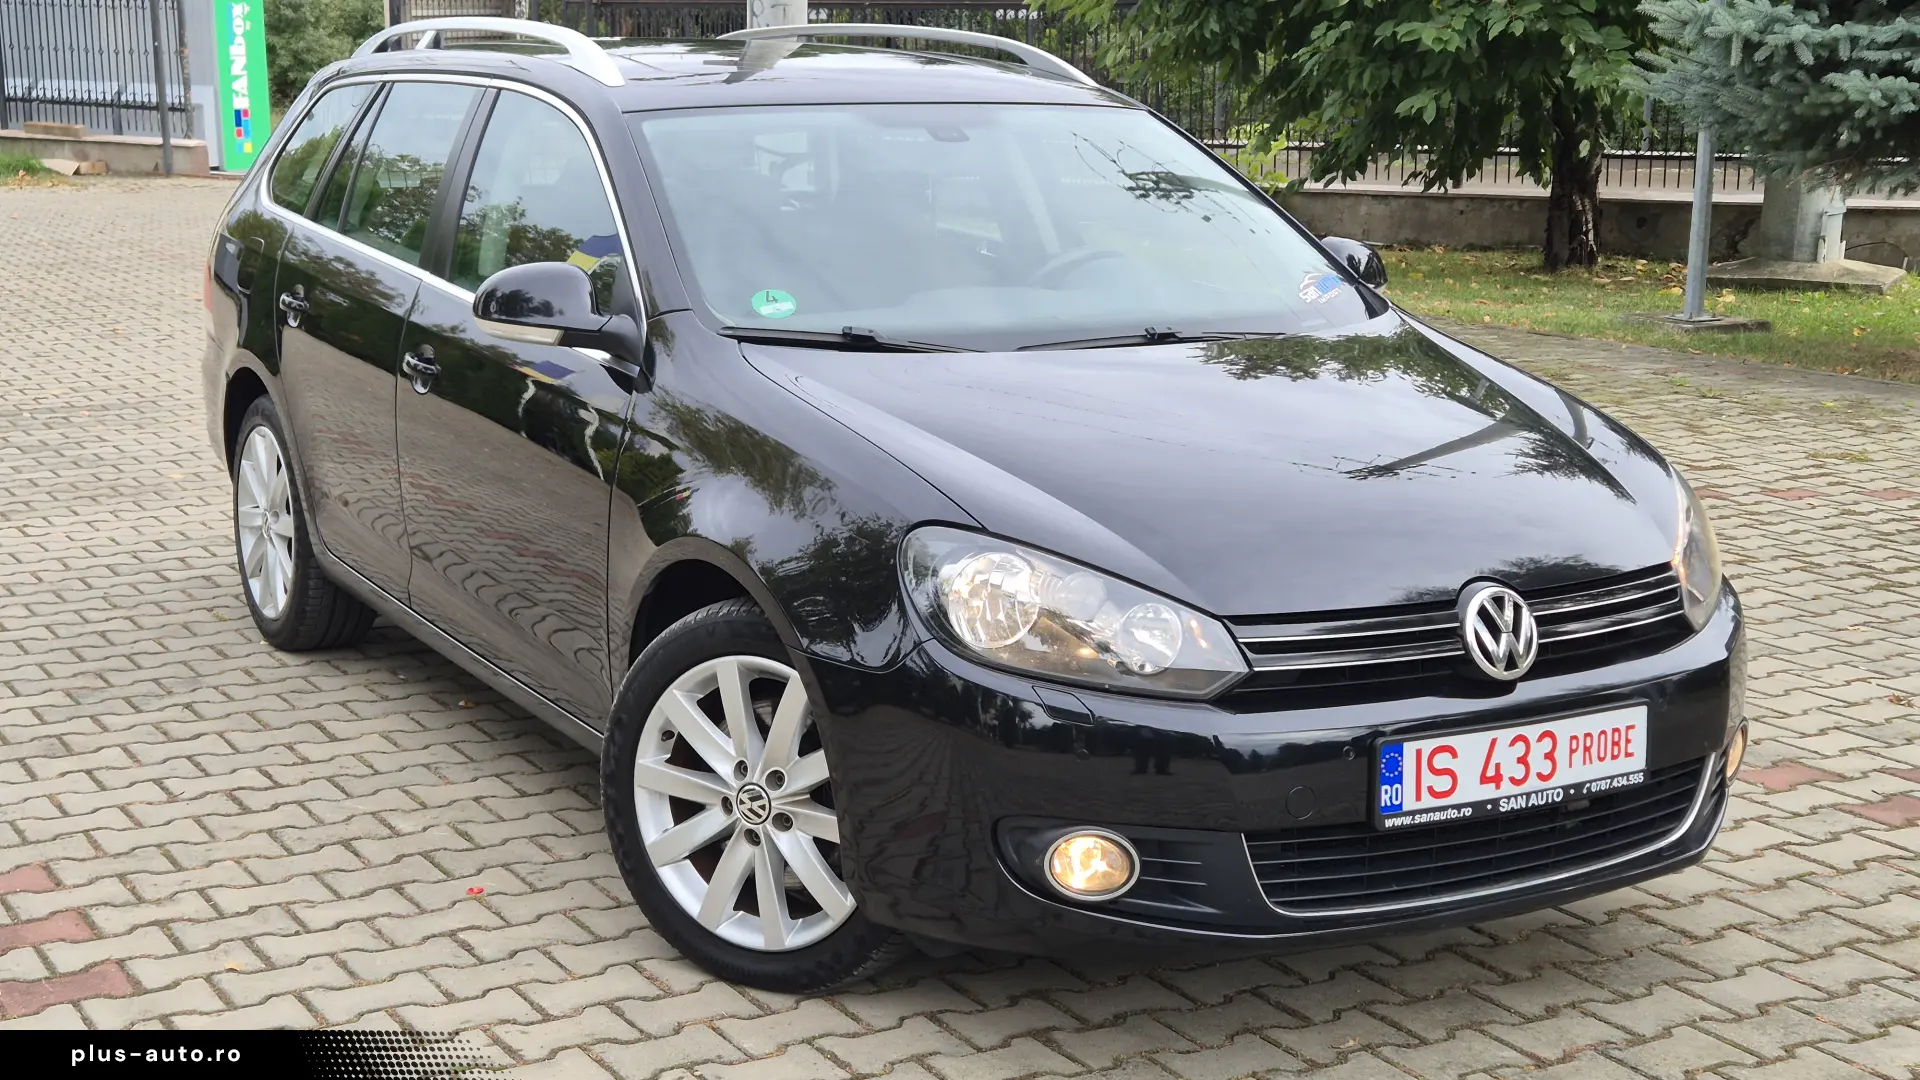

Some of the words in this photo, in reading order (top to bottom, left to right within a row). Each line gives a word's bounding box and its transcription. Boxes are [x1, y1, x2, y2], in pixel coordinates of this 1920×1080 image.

[229, 2, 250, 110] FANbox
[766, 290, 778, 303] 4
[1415, 744, 1459, 802] IS
[1479, 729, 1559, 791] 433
[1568, 724, 1637, 769] PROBE
[1381, 783, 1401, 807] RO
[1384, 806, 1473, 828] www.sanauto.ro
[1499, 794, 1527, 812] SAN
[1528, 787, 1564, 808] AUTO
[1591, 772, 1645, 793] 0787.434.555
